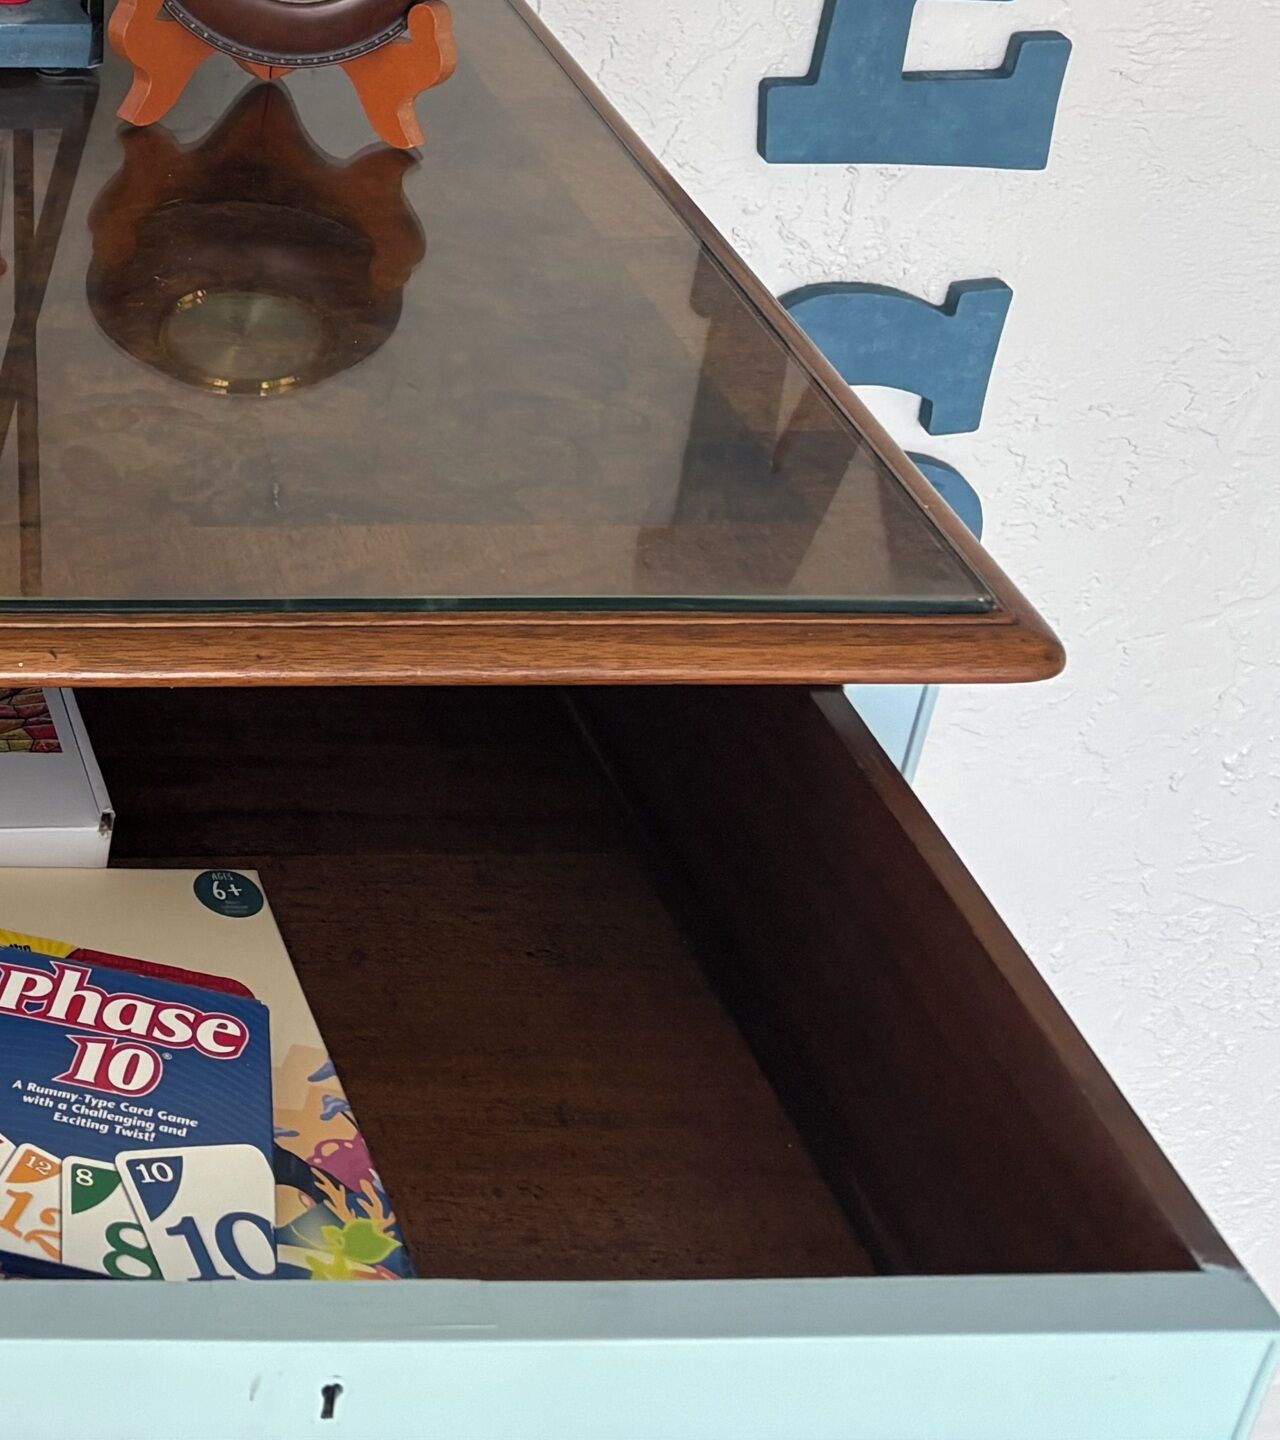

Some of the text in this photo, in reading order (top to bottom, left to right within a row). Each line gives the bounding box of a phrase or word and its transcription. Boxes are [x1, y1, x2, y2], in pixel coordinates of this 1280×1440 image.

[213, 881, 242, 900] 6+
[60, 1037, 160, 1094] 10
[12, 1080, 198, 1127] A Rummy-Type Card Game
[136, 1162, 174, 1184] 10
